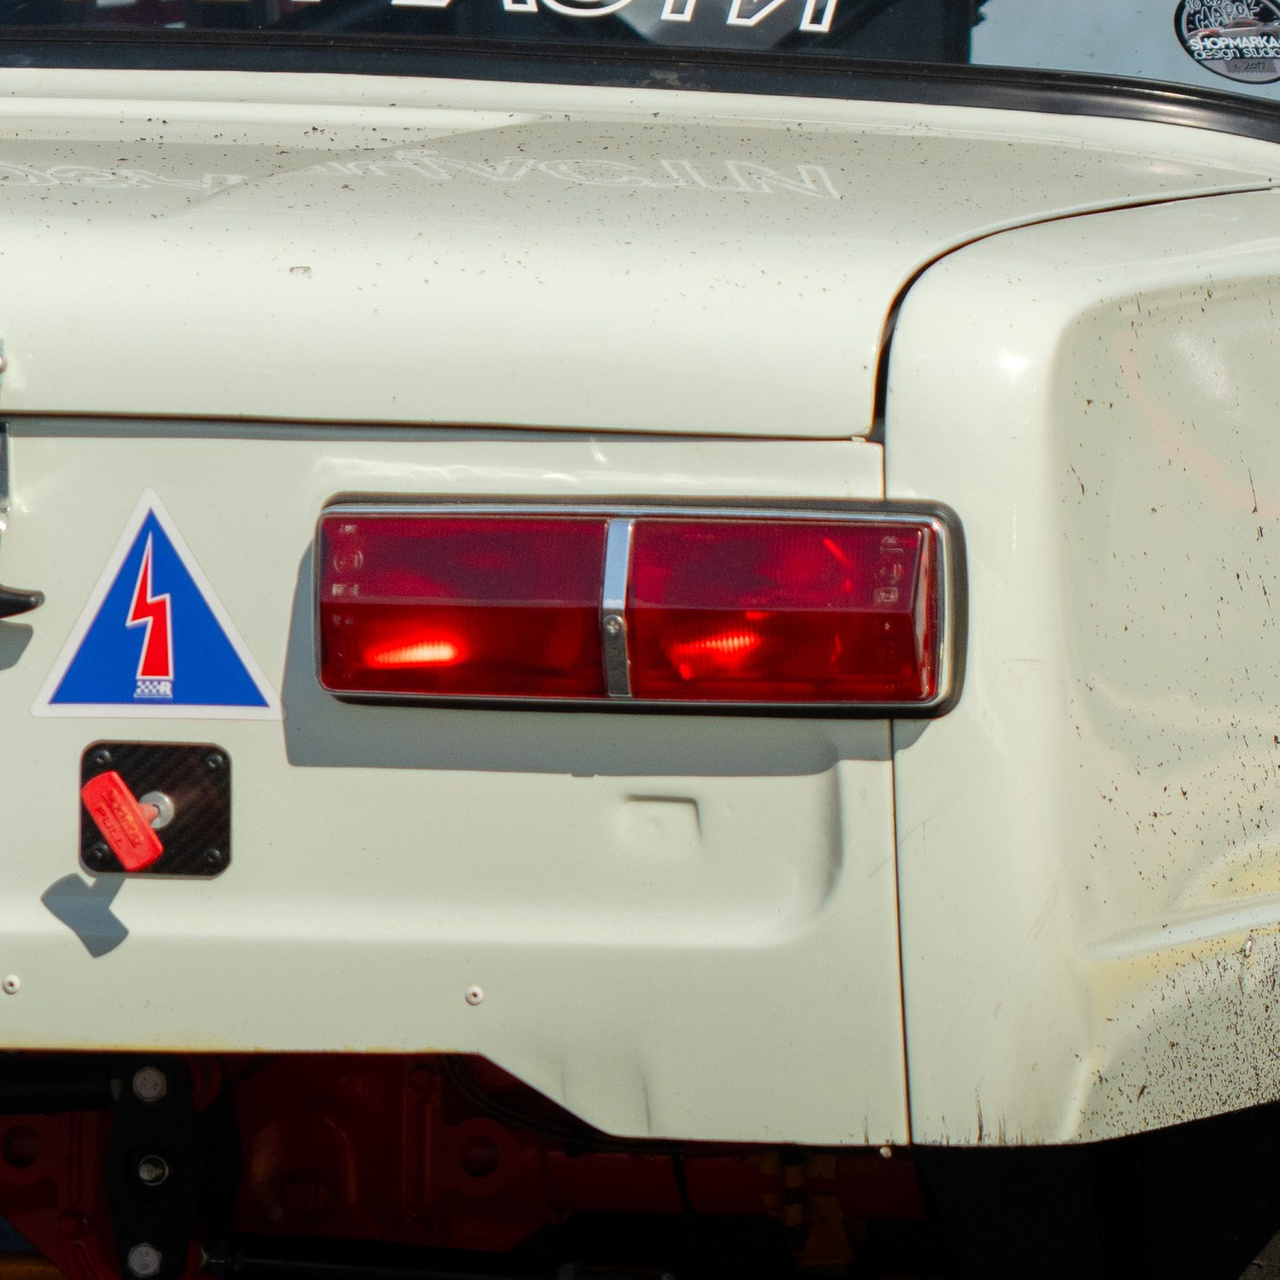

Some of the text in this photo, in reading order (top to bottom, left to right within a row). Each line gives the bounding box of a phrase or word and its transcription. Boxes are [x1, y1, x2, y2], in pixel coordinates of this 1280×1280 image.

[1189, 35, 1280, 50] SHOPMARKA
[1194, 47, 1240, 61] design
[94, 805, 123, 851] PULL
